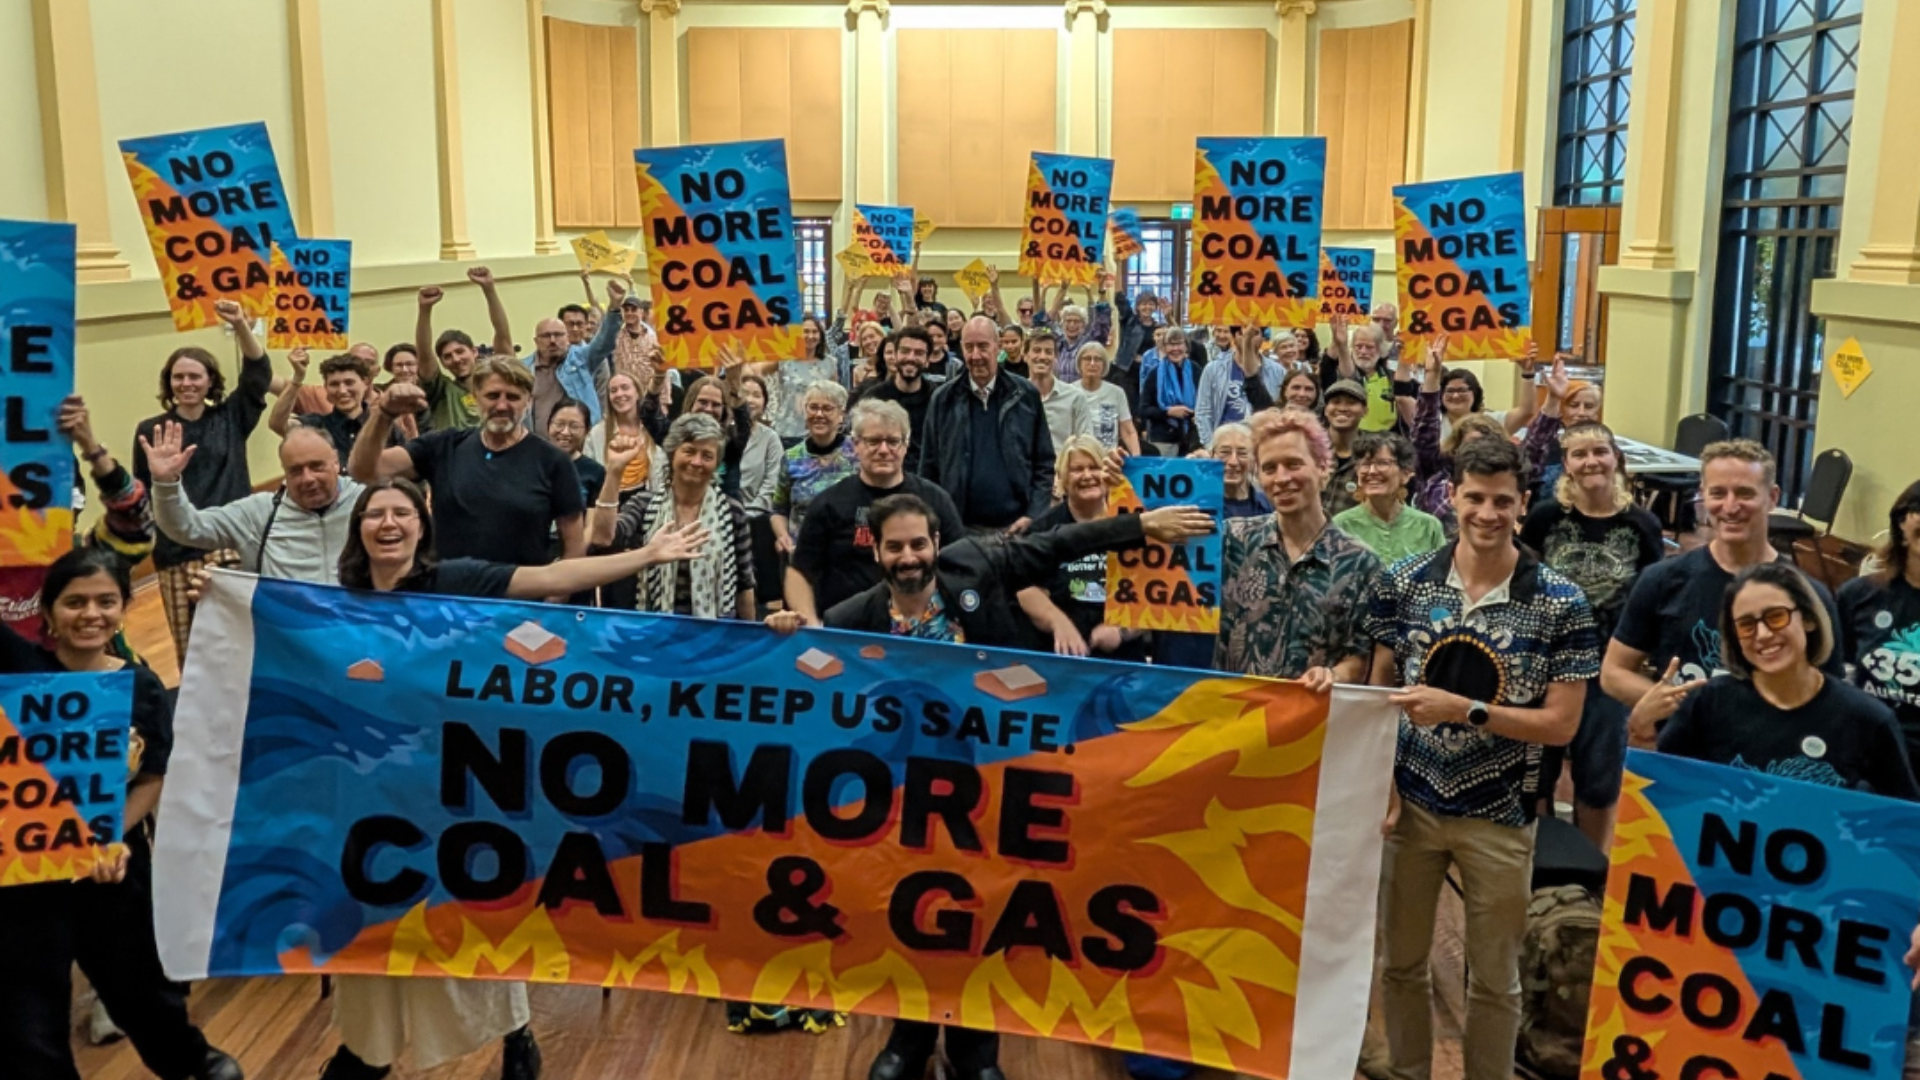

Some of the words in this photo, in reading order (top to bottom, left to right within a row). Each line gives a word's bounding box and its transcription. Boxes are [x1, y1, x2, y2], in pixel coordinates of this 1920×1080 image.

[168, 150, 234, 186] NO
[1051, 168, 1088, 189] NO
[1229, 158, 1286, 187] NO
[679, 168, 745, 204] NO
[149, 180, 278, 225] MORE
[1030, 190, 1104, 215] MORE
[1200, 194, 1313, 223] MORE
[1429, 197, 1485, 229] NO
[653, 206, 783, 247] MORE
[856, 224, 909, 237] MORE
[869, 213, 897, 224] NO
[1029, 215, 1098, 240] COAL
[294, 248, 330, 266] NO
[870, 252, 907, 265] GAS
[1025, 240, 1043, 259] &
[1046, 242, 1097, 263] GAS
[1200, 232, 1308, 261] COAL
[1403, 228, 1518, 264] MORE
[660, 253, 785, 292] COAL
[1335, 255, 1360, 267] NO
[176, 273, 207, 301] &
[211, 265, 270, 292] GA
[274, 270, 347, 288] MORE
[1196, 270, 1224, 297] &
[1229, 270, 1308, 299] GAS
[1322, 269, 1371, 283] MORE
[1407, 267, 1518, 300] COAL
[274, 293, 345, 312] COAL
[1322, 285, 1370, 299] COAL
[664, 304, 696, 336] &
[702, 295, 792, 331] GAS
[1320, 301, 1332, 314] &
[1334, 303, 1370, 315] GAS
[1408, 309, 1435, 335] &
[1440, 302, 1521, 332] GAS
[273, 316, 290, 334] &
[294, 317, 345, 335] GAS
[1142, 473, 1193, 499] NO
[1116, 544, 1216, 572] COAL
[1114, 578, 1138, 603] &
[1144, 579, 1216, 609] GAS
[20, 691, 90, 724] NO
[446, 660, 652, 722] LABOR,
[668, 681, 815, 727] KEEP
[831, 692, 902, 734] US
[921, 700, 1076, 756] SAFE.
[440, 721, 630, 817] NO
[682, 739, 1074, 863] MORE
[15, 815, 114, 853] GAS
[1698, 812, 1826, 886] NO
[340, 815, 711, 924] COAL
[753, 855, 846, 940] &
[888, 870, 1161, 971] GAS
[1623, 873, 1890, 986] MORE
[1618, 956, 1871, 1071] COAL
